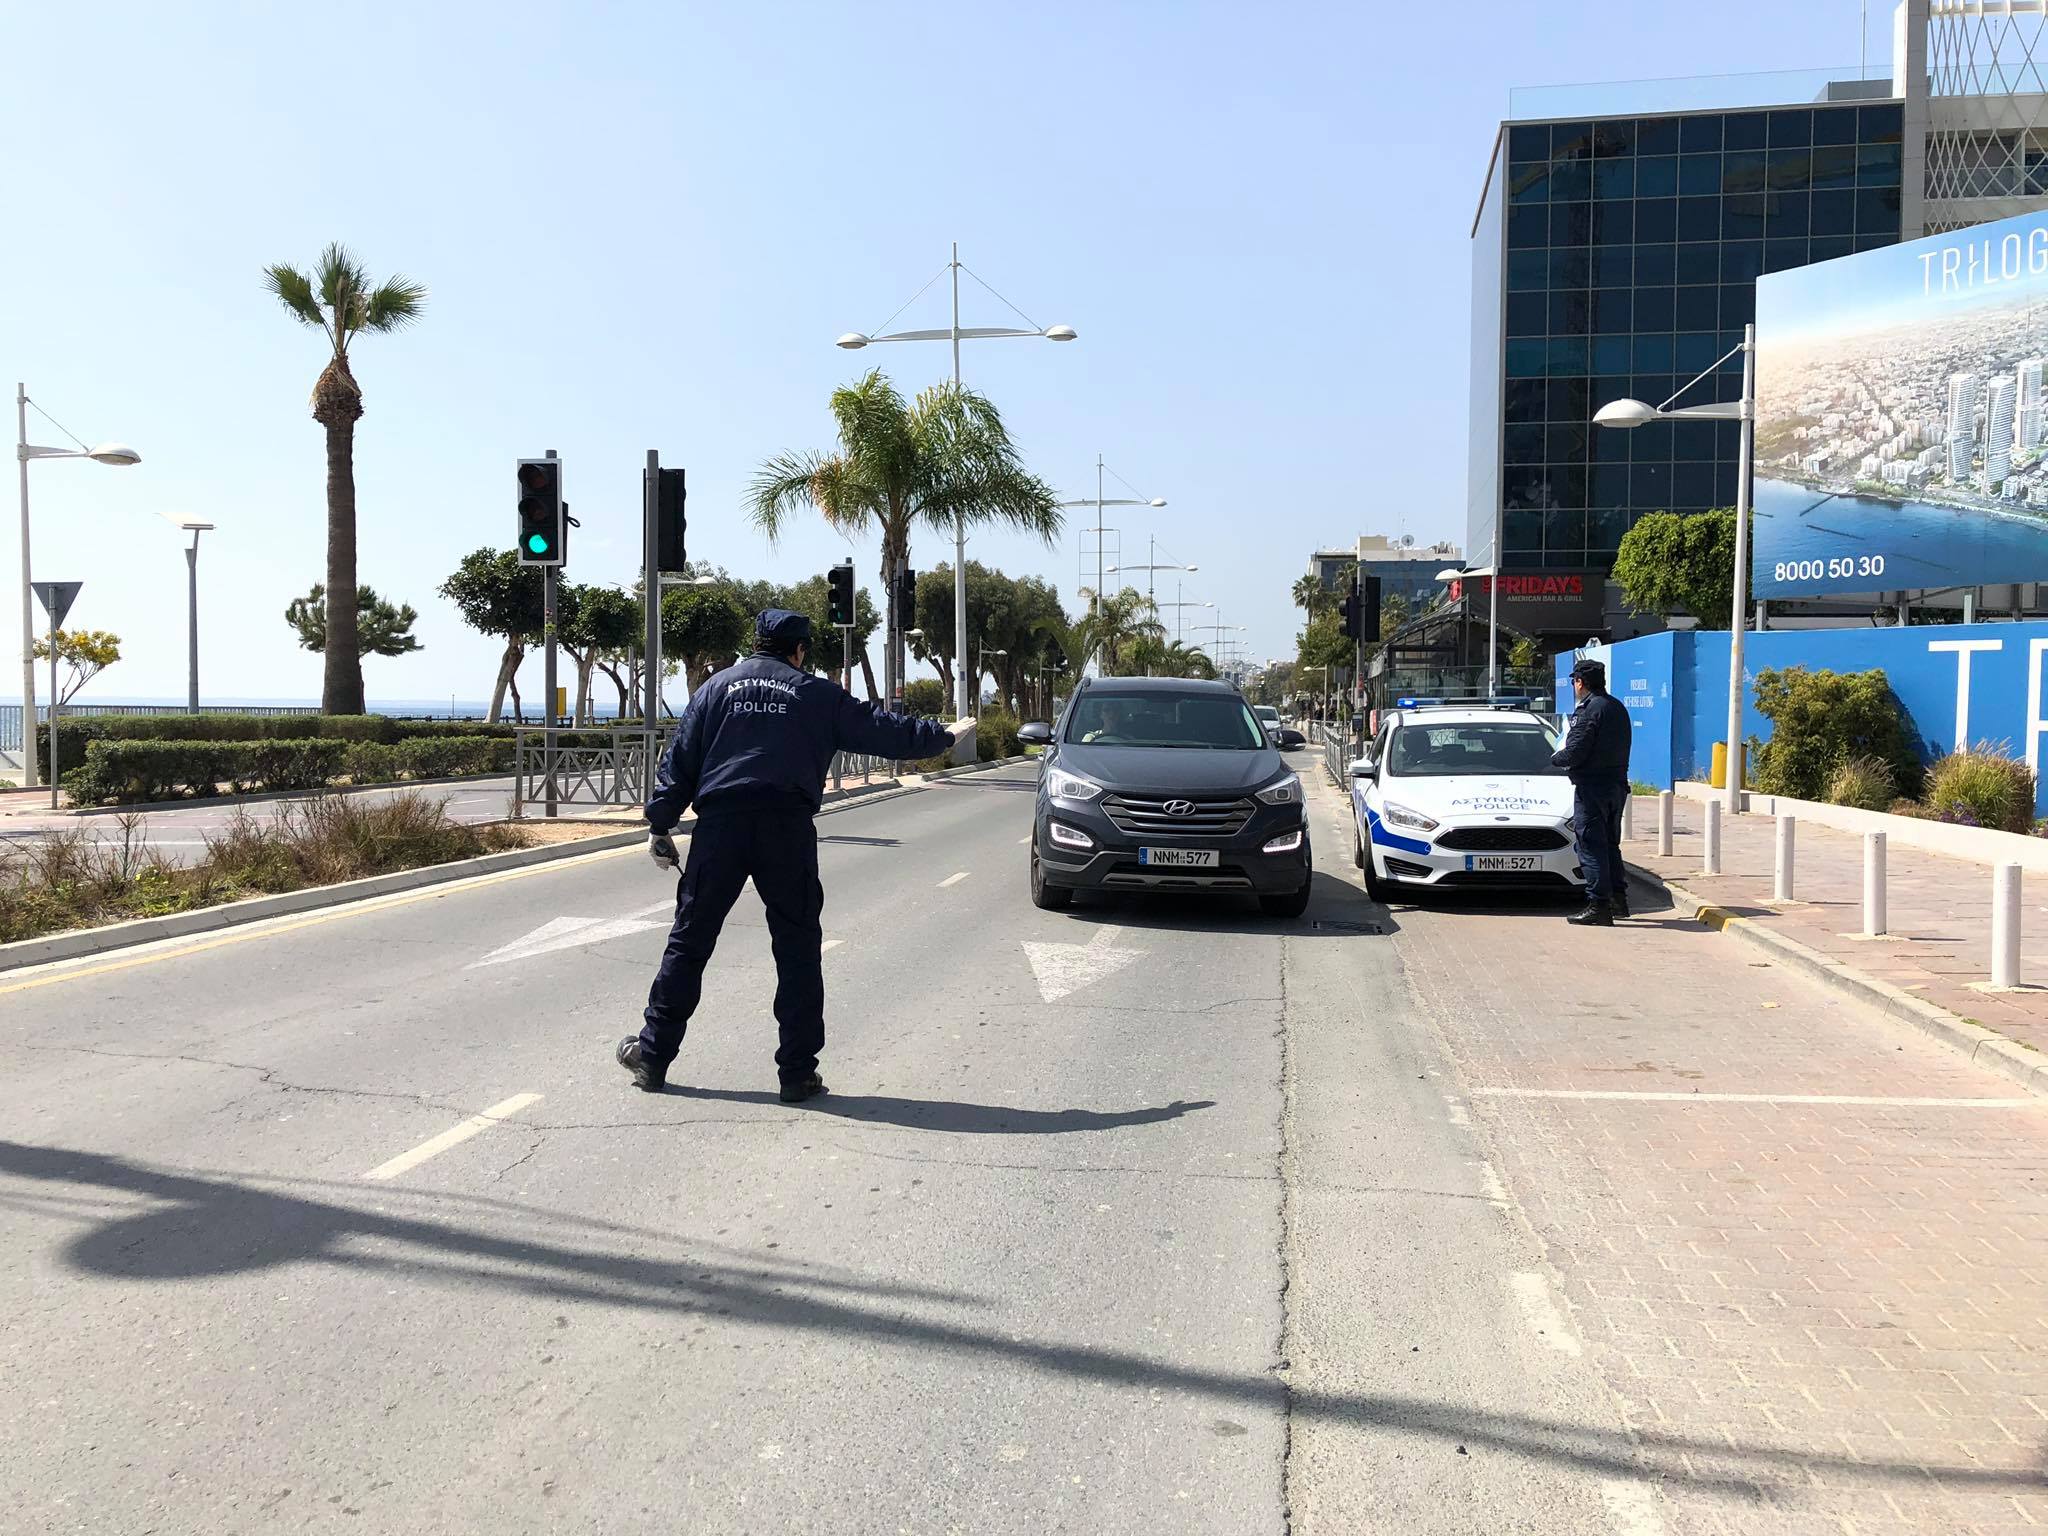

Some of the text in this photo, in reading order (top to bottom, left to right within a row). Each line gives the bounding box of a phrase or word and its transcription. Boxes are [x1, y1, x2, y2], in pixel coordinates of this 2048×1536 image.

[1775, 555, 1885, 582] 8000 50 30
[1497, 575, 1584, 594] FRIDAYS
[1507, 594, 1542, 602] AMERICAN
[1542, 594, 1556, 602] BAR
[1564, 594, 1583, 602] GRILL
[733, 701, 787, 714] POLICE
[1153, 850, 1211, 864] NNM 577
[1479, 857, 1535, 869] MNM 527
